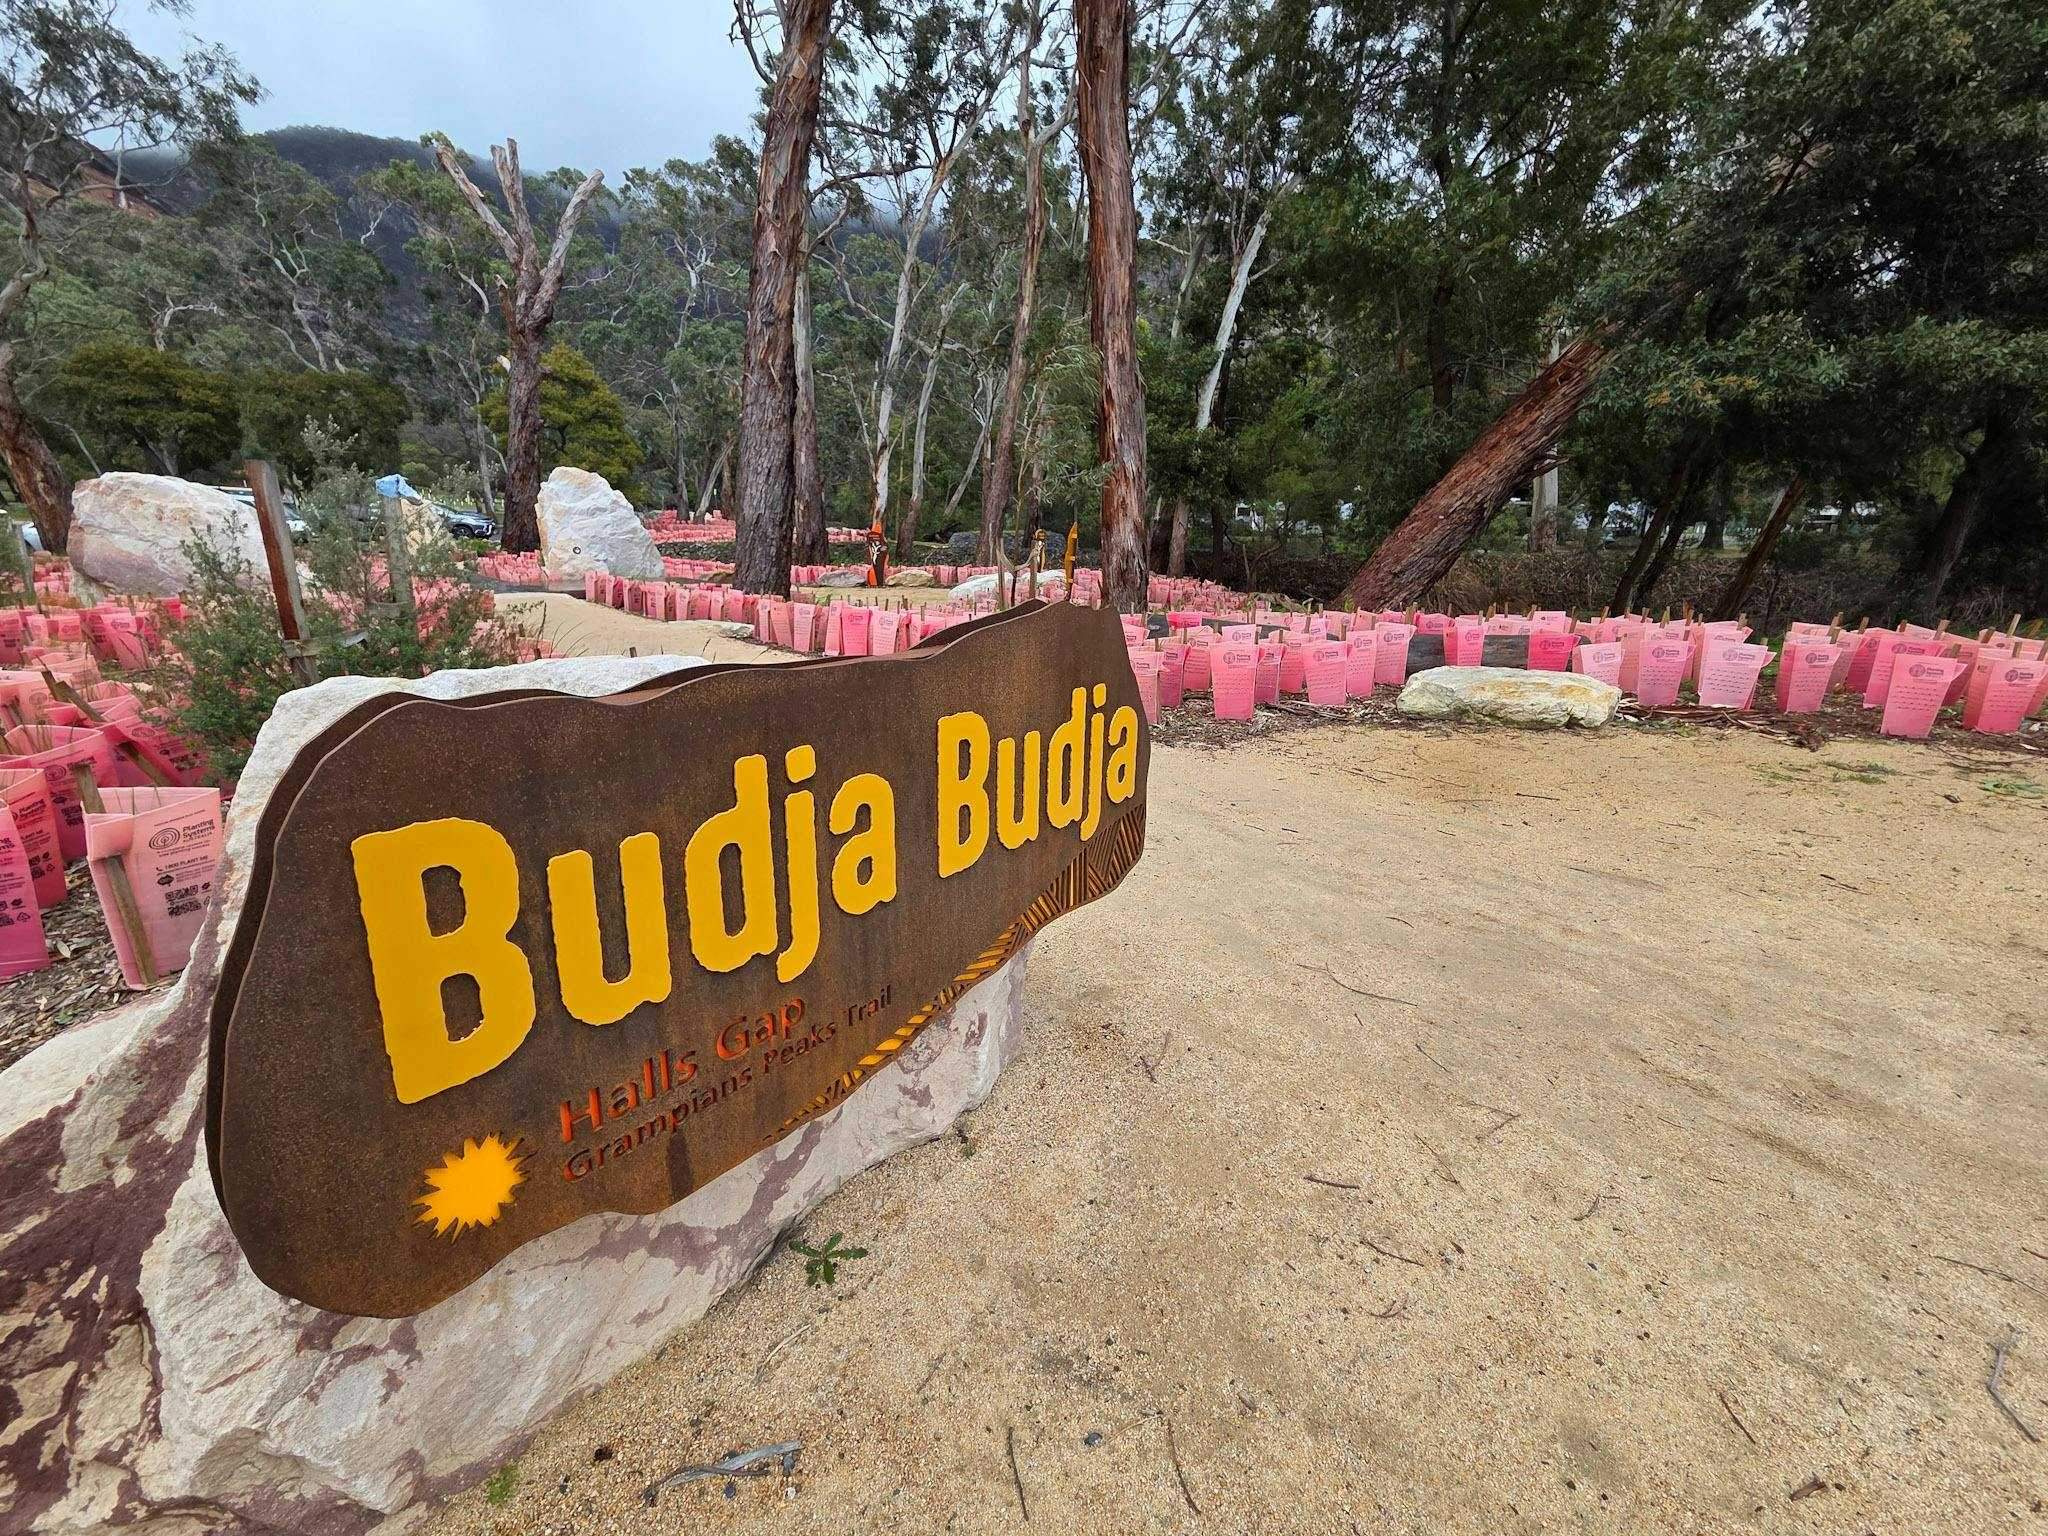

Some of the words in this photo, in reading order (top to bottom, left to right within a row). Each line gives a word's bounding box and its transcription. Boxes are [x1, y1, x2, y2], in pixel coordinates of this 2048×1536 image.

[183, 819, 214, 832] Planting
[351, 744, 897, 1105] Budja
[936, 682, 1139, 878] Budja
[560, 1049, 697, 1143] Halls
[716, 997, 806, 1061] Gap
[562, 1065, 753, 1181] Grampians
[763, 1020, 837, 1073] Peaks
[844, 984, 892, 1028] Trail
